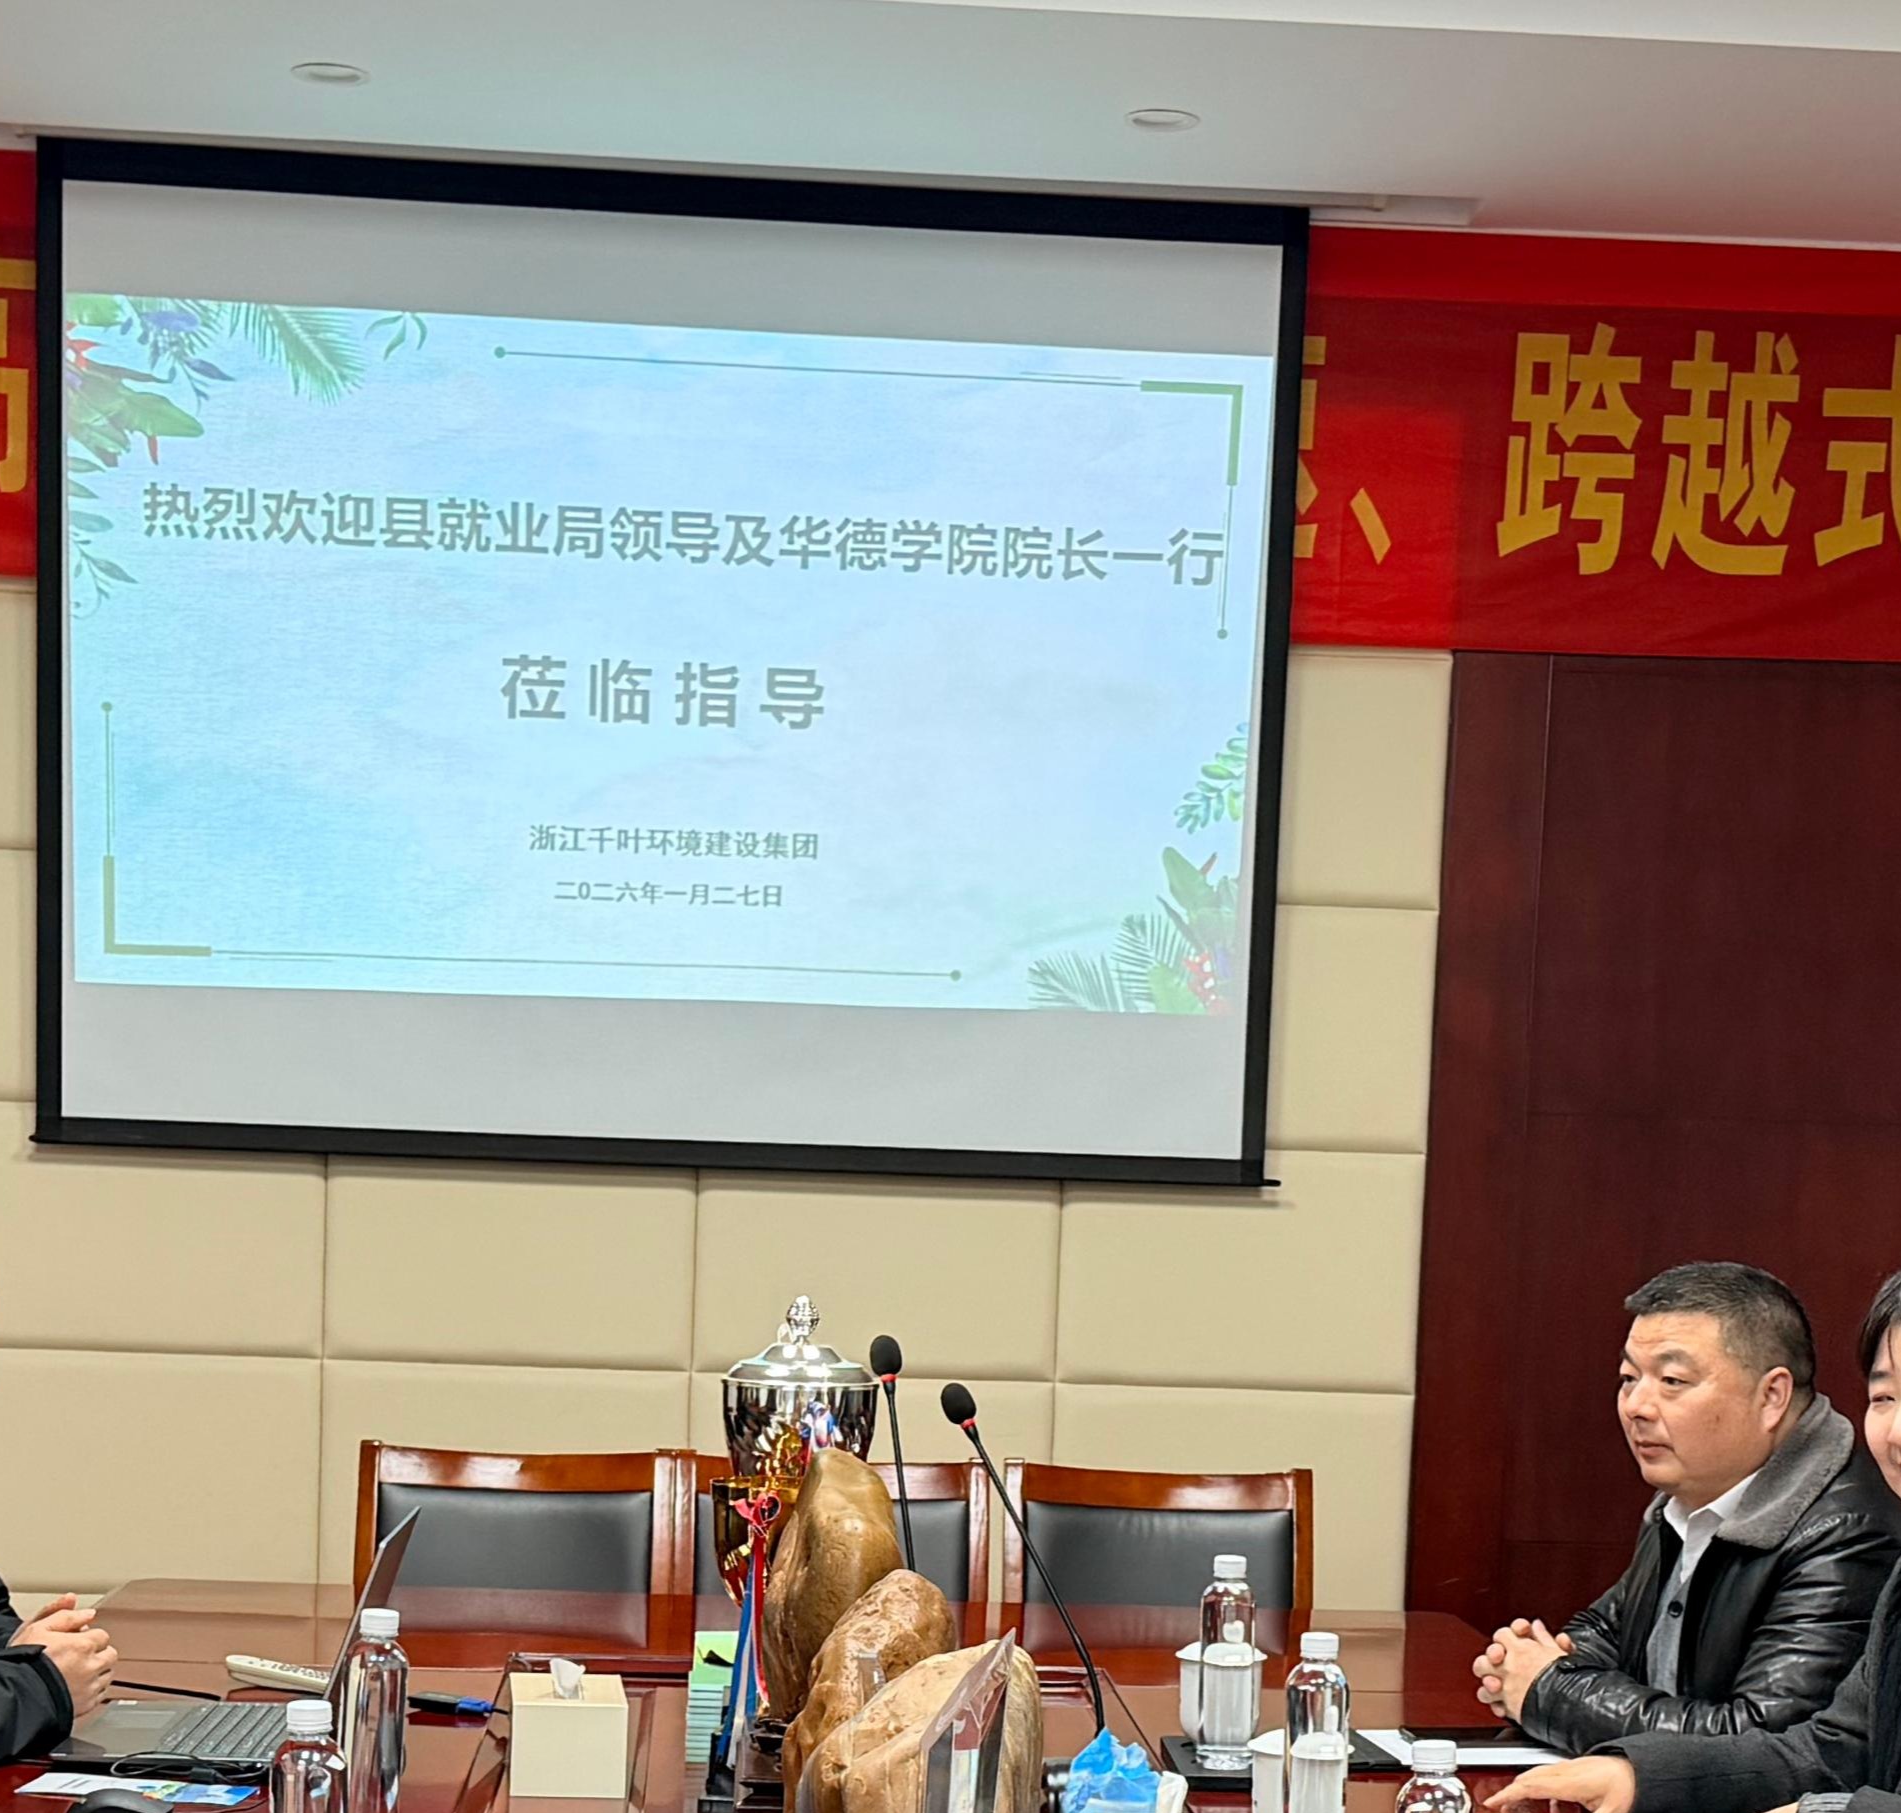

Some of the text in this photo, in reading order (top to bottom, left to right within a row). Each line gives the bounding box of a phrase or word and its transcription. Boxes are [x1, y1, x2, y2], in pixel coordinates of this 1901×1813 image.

[142, 481, 1225, 589] 热烈欢迎县就业局领导及华德学院院长一行
[499, 653, 827, 731] 莅临指导
[529, 824, 820, 860] 浙江千叶环境建设集团
